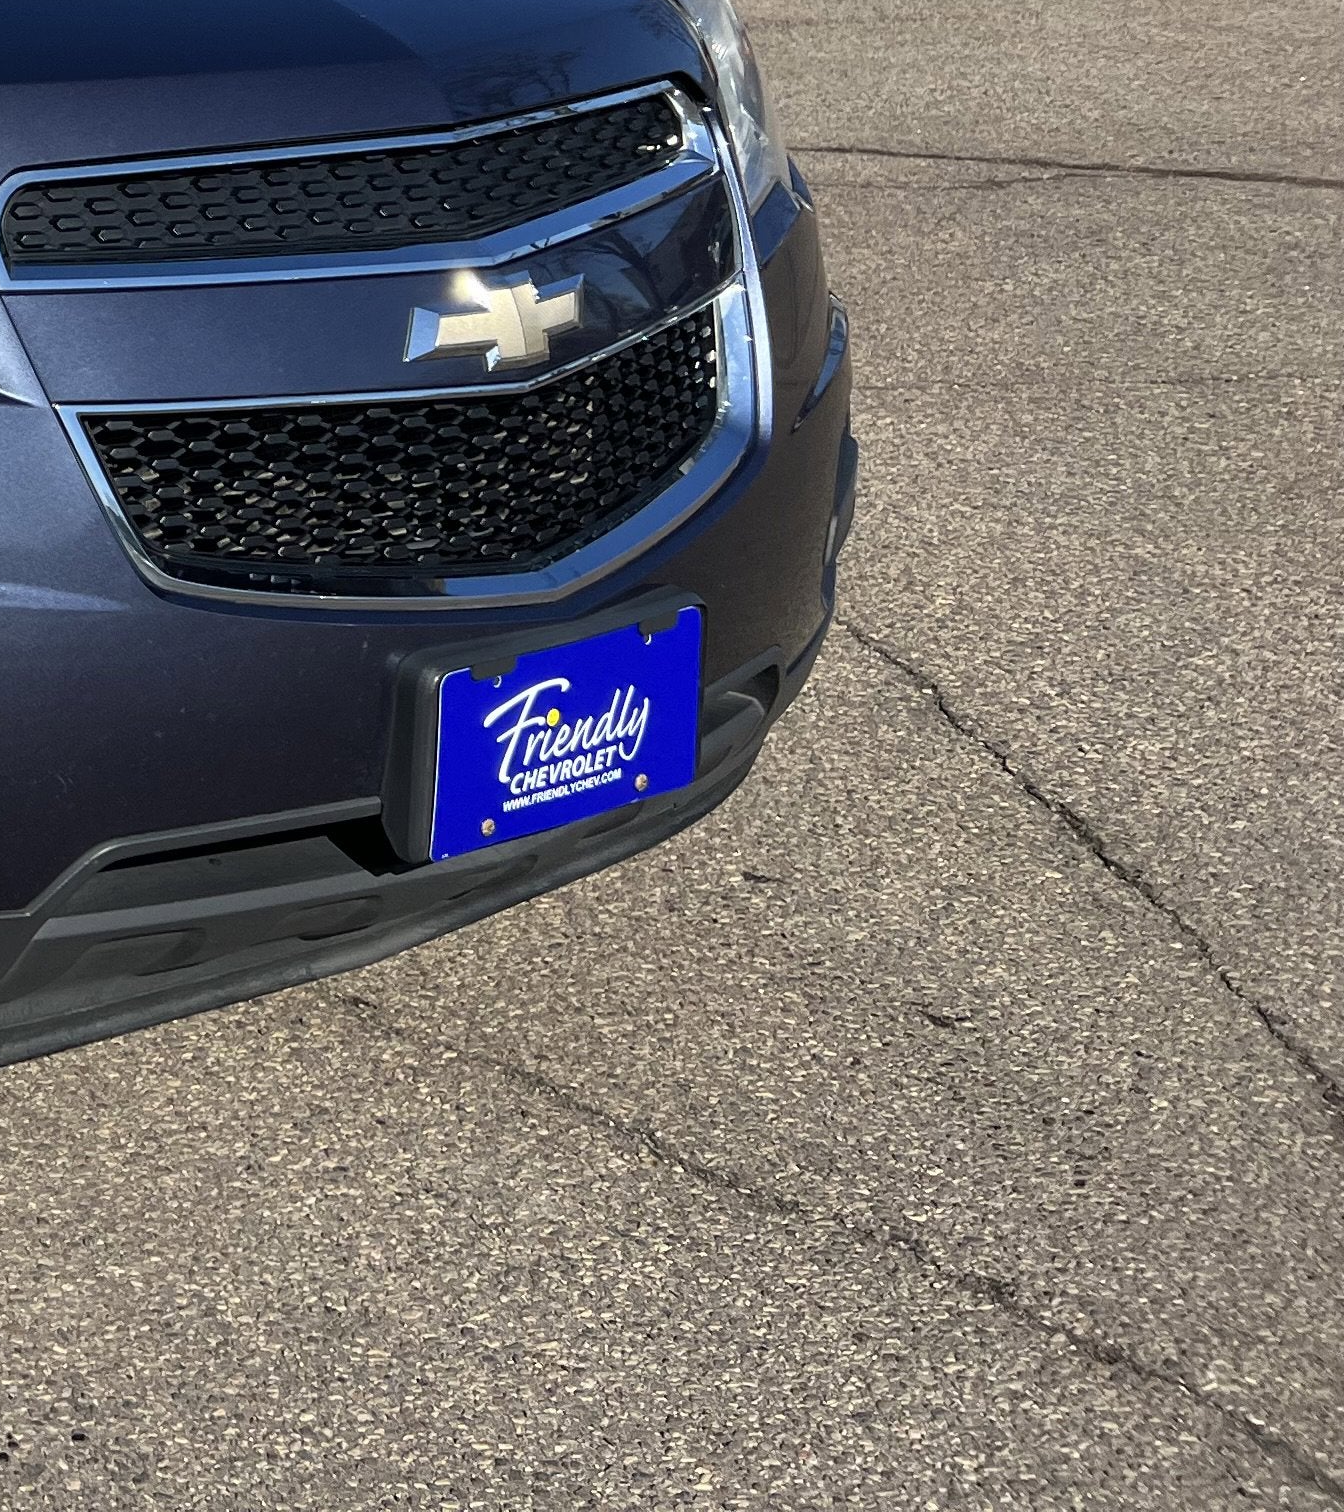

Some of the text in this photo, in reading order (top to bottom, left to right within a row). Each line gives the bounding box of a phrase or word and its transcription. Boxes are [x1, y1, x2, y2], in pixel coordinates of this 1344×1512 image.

[483, 678, 649, 783] Friendly
[502, 768, 622, 812] WWW.FRIENDLYCHEV.COM
[510, 745, 615, 794] CHEVROLET
